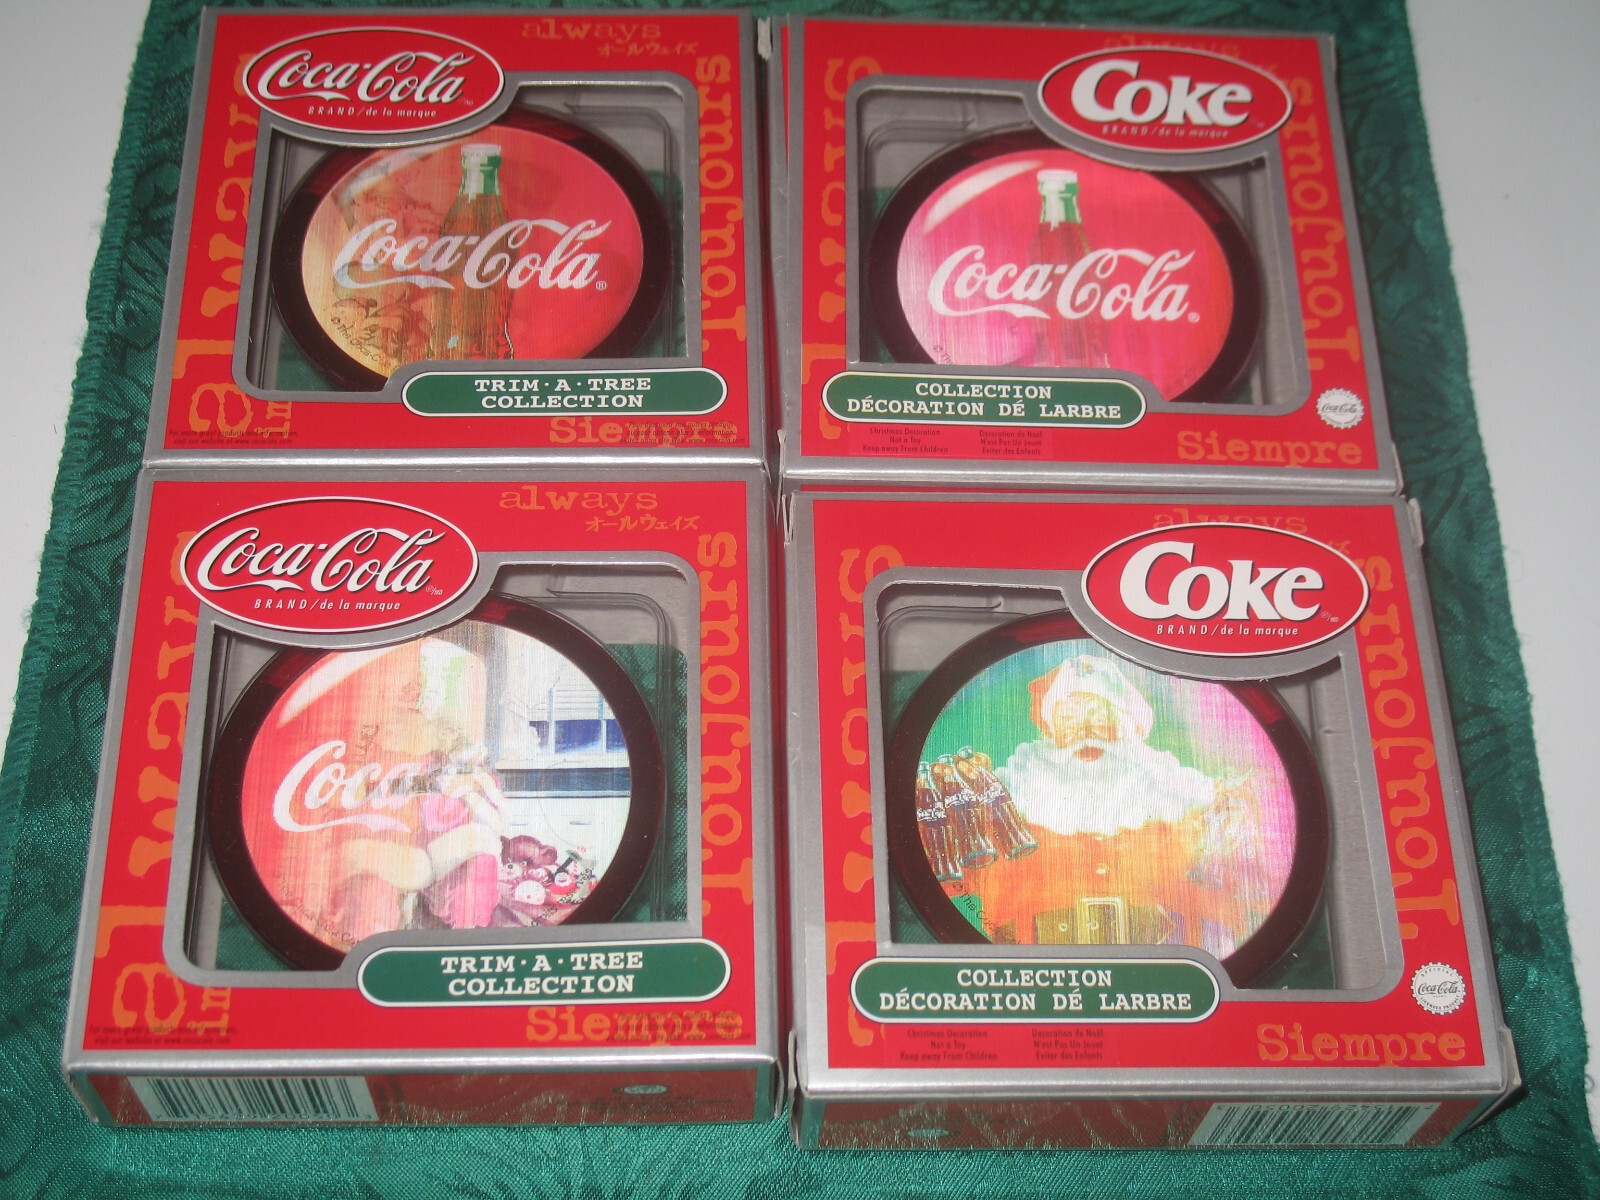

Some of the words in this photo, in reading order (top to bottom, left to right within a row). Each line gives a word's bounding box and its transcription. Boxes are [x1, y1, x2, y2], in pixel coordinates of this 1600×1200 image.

[522, 18, 661, 44] always
[257, 50, 476, 104] Coca-Cola
[1071, 58, 1253, 127] Coke
[332, 218, 612, 290] Coca-Cola
[928, 245, 1196, 321] Coca-Cola
[481, 394, 644, 409] COLLECTION
[915, 382, 1052, 399] COLLECTION
[847, 395, 984, 416] DÉCORATION
[999, 400, 1025, 416] DÉ
[1040, 404, 1121, 419] LARBRE
[1177, 430, 1362, 468] Siempre
[498, 485, 658, 516] always
[585, 513, 700, 533] オールウェイズ
[197, 527, 447, 593] Coca-Cola
[1120, 541, 1323, 622] Coke
[339, 599, 349, 610] la
[355, 601, 400, 612] marque
[1239, 624, 1249, 635] la
[1255, 626, 1298, 637] marque
[448, 974, 635, 997] COLLECTION
[956, 969, 1112, 987] COLLECTION
[879, 987, 1036, 1011] DÉCORATION
[1052, 988, 1083, 1011] DÉ
[1099, 993, 1192, 1011] LARBRE
[1256, 1022, 1466, 1067] Siempre
